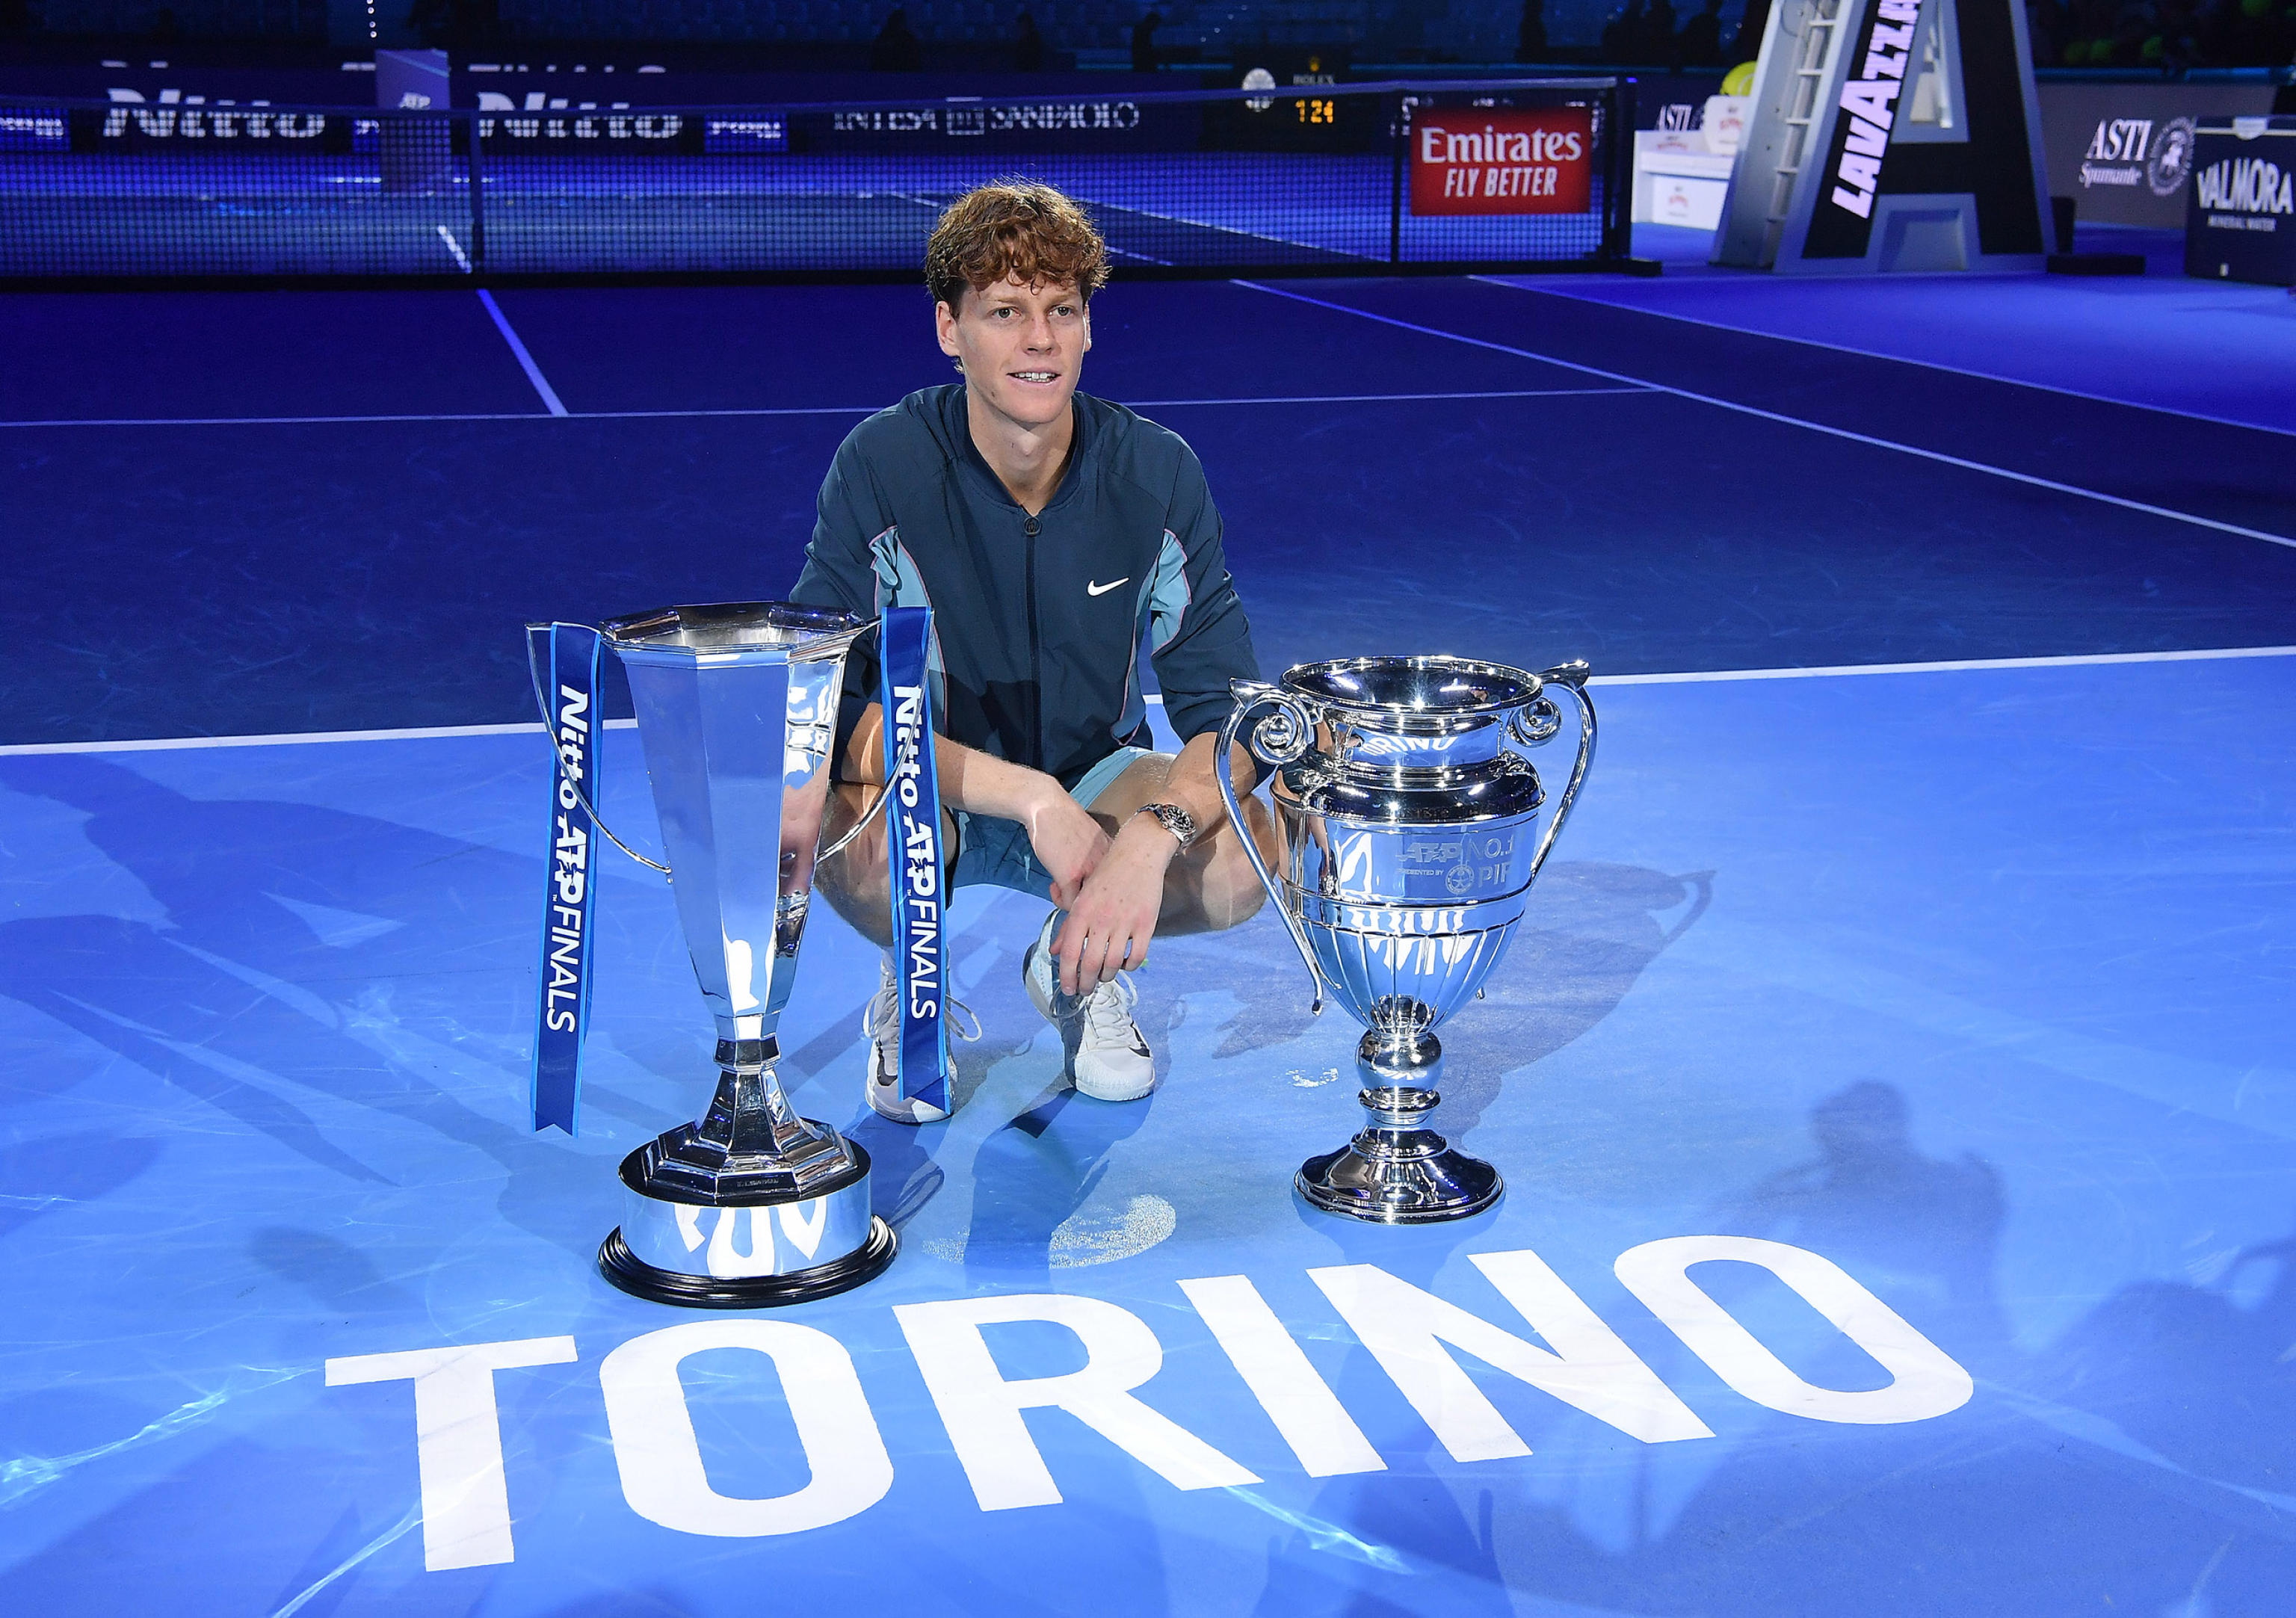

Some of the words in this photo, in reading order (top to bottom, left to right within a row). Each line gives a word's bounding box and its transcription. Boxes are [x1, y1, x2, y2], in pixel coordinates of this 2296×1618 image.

[103, 88, 325, 138] Nitto
[478, 92, 682, 138] Nitto
[1832, 0, 1922, 218] LAVAZZA
[1421, 125, 1582, 164] Emirates
[2084, 118, 2154, 161] ASTI
[1444, 167, 1480, 197] FLY
[1484, 166, 1558, 197] BETTER
[2196, 157, 2295, 214] VALMORA
[558, 684, 588, 809] Nitto
[894, 685, 922, 808] Nitto
[909, 899, 938, 1019] FINALS
[546, 904, 581, 1033] FINALS
[324, 1235, 1974, 1572] TORINO
